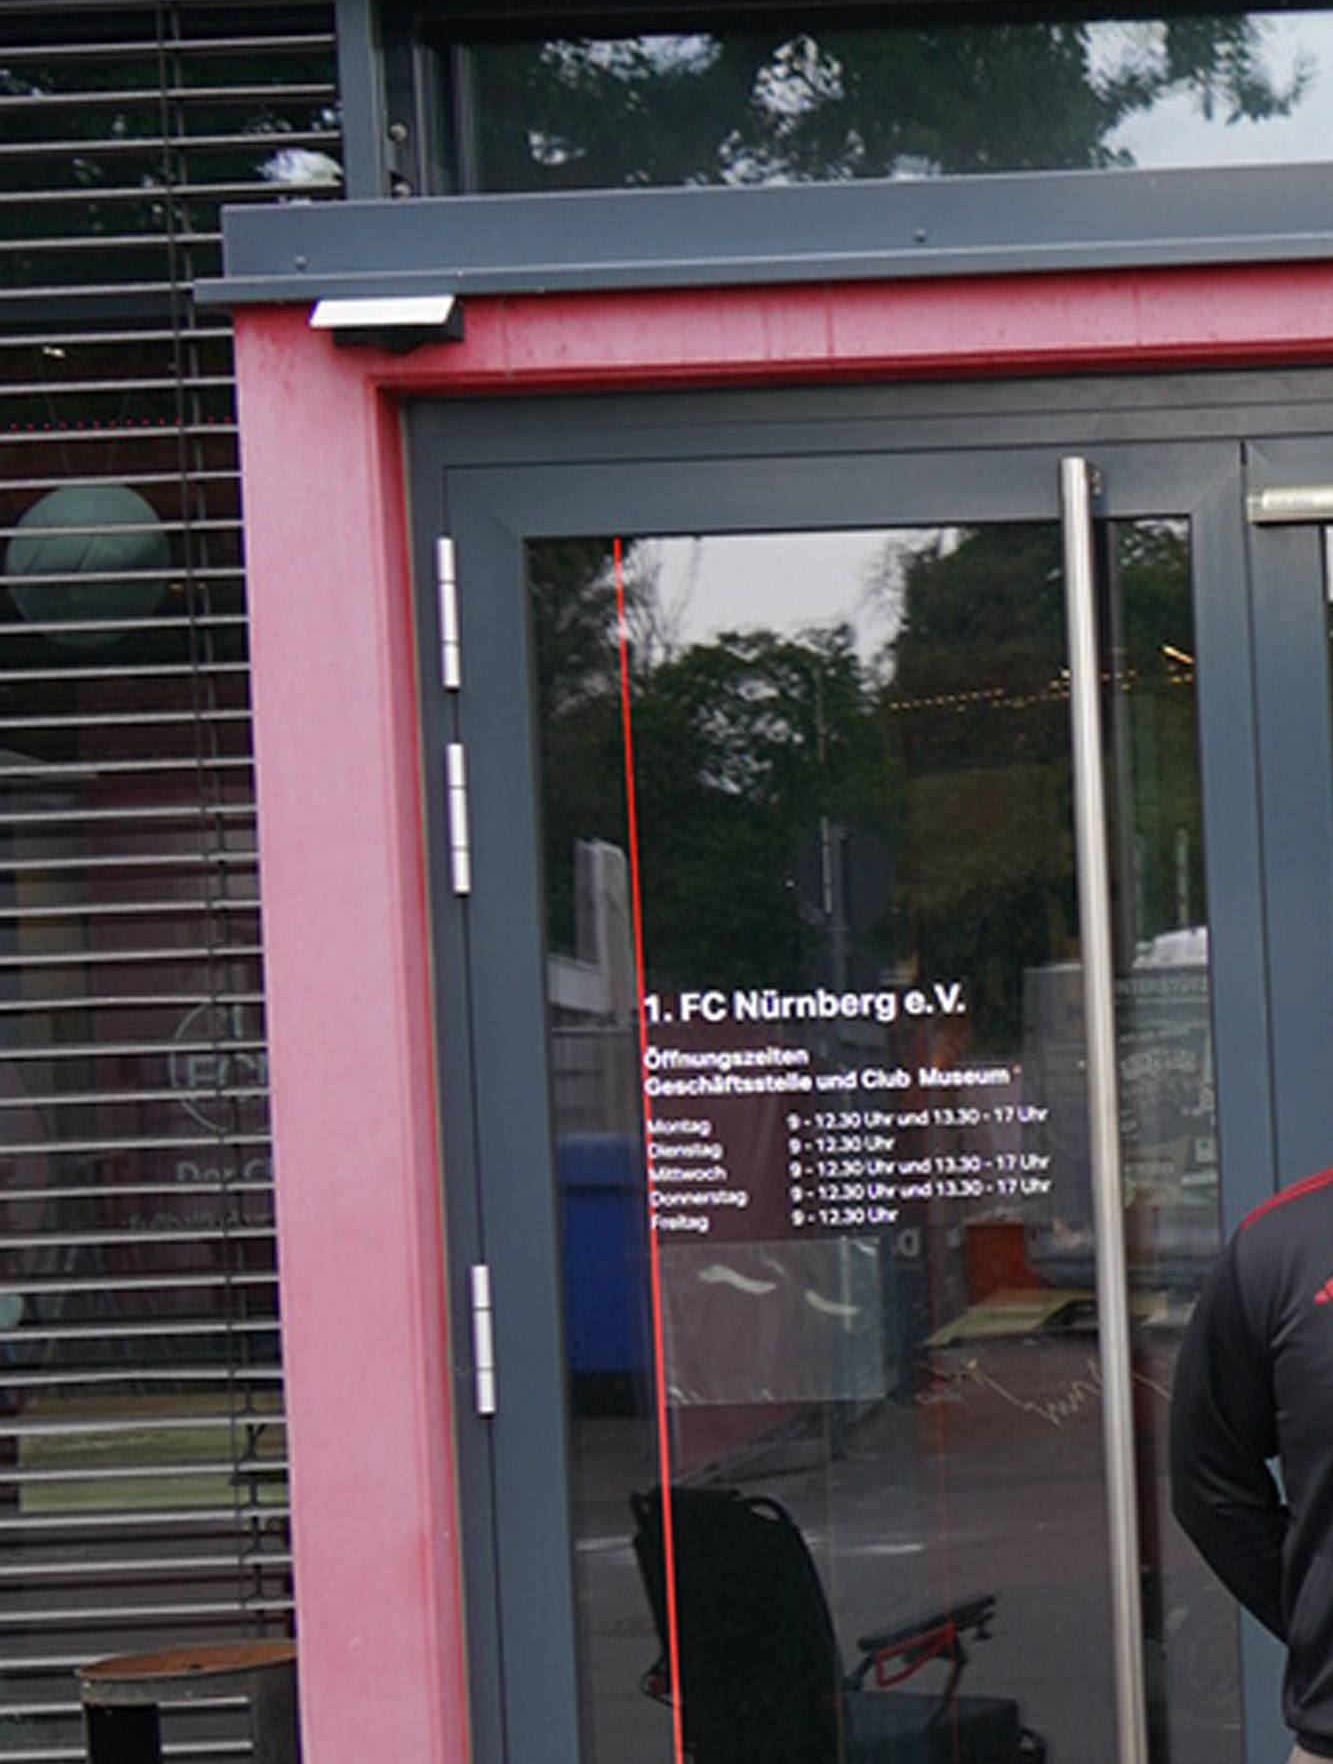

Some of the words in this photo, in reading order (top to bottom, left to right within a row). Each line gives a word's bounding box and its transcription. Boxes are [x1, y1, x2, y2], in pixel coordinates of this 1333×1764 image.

[644, 994, 673, 1022] 1.
[680, 991, 727, 1021] FC
[734, 988, 896, 1022] Nürnberg
[904, 983, 967, 1015] e.V.
[644, 1045, 809, 1071] Öffnungszeiten
[644, 1073, 813, 1097] Geschäftsstelle
[816, 1071, 857, 1091] und
[860, 1067, 912, 1089] Club
[918, 1066, 1011, 1086] Museum
[647, 1119, 712, 1137] Montag
[864, 1111, 894, 1128] Uhr
[897, 1109, 929, 1126] und
[994, 1106, 1014, 1123] 17
[1017, 1105, 1048, 1123] Uhr
[648, 1143, 723, 1161] Dienstag
[864, 1135, 895, 1152] Uhr
[649, 1165, 728, 1182] Mittwoch
[866, 1159, 896, 1175] Uhr
[898, 1157, 931, 1174] und
[997, 1153, 1017, 1171] 17
[1020, 1153, 1050, 1171] Uhr
[649, 1190, 748, 1208] Donnerstag
[867, 1182, 897, 1200] Uhr
[900, 1180, 932, 1198] und
[997, 1178, 1017, 1195] 17
[1020, 1177, 1051, 1195] Uhr
[650, 1213, 709, 1233] Freitag
[867, 1206, 899, 1224] Uhr
